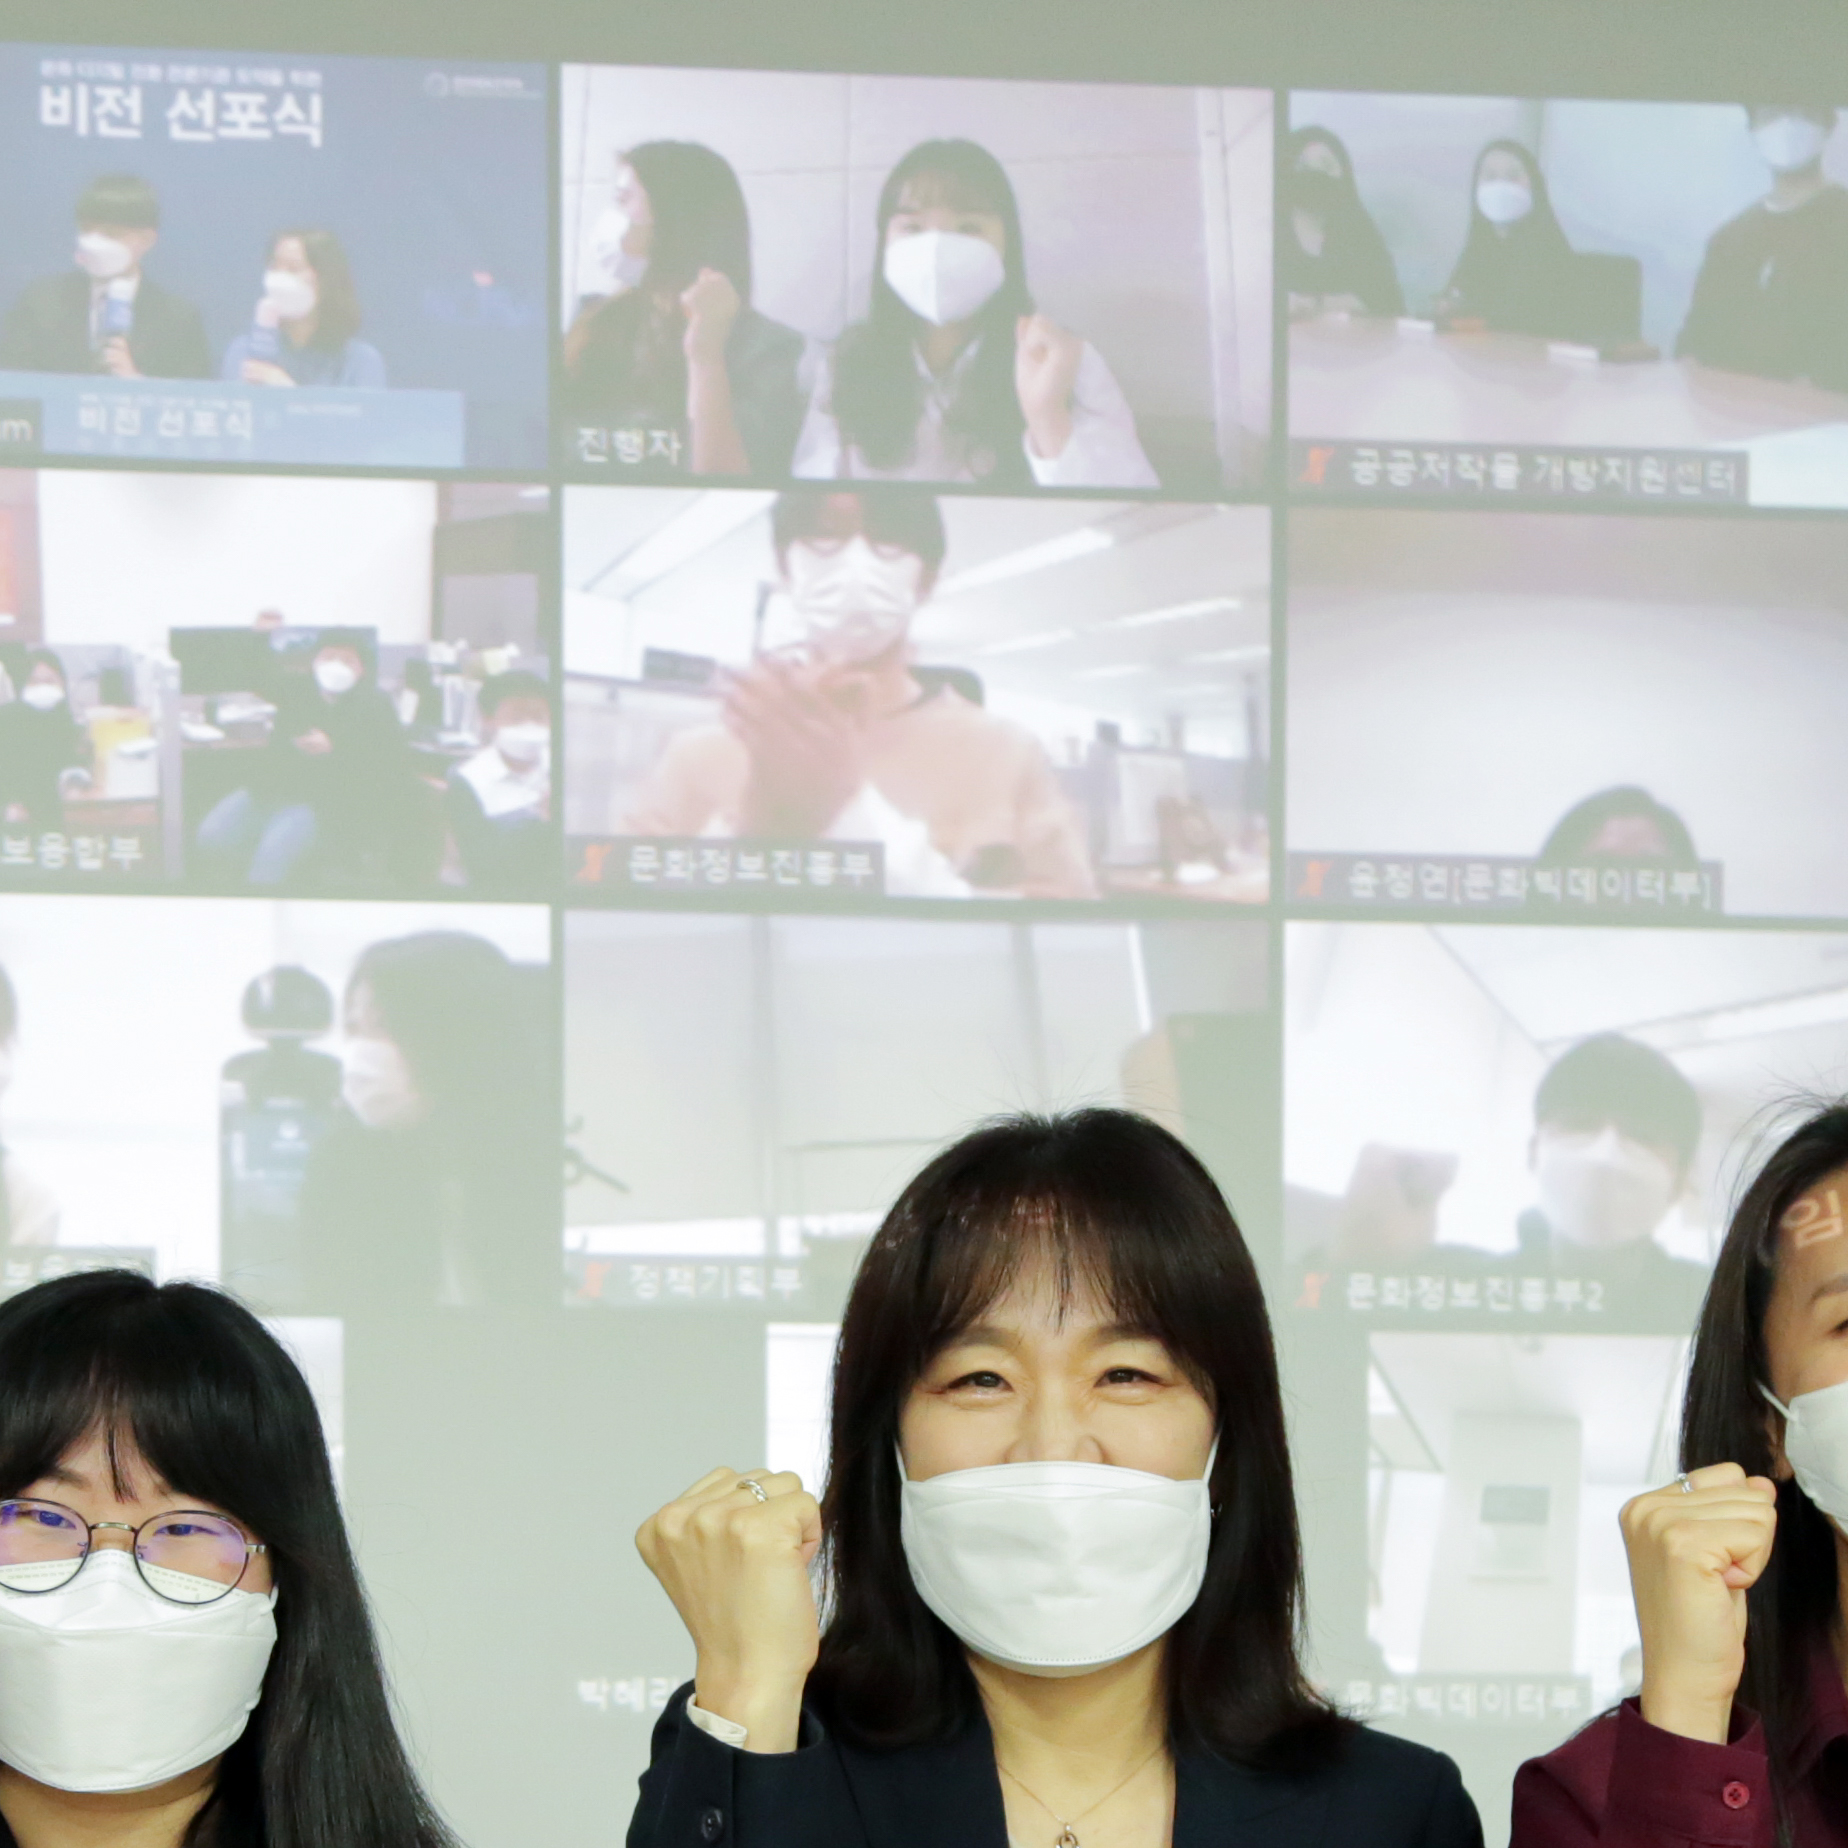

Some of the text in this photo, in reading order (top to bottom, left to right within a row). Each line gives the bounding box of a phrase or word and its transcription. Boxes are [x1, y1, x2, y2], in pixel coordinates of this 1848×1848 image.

[39, 82, 323, 148] 비전 선포식
[577, 426, 682, 466] 진행자
